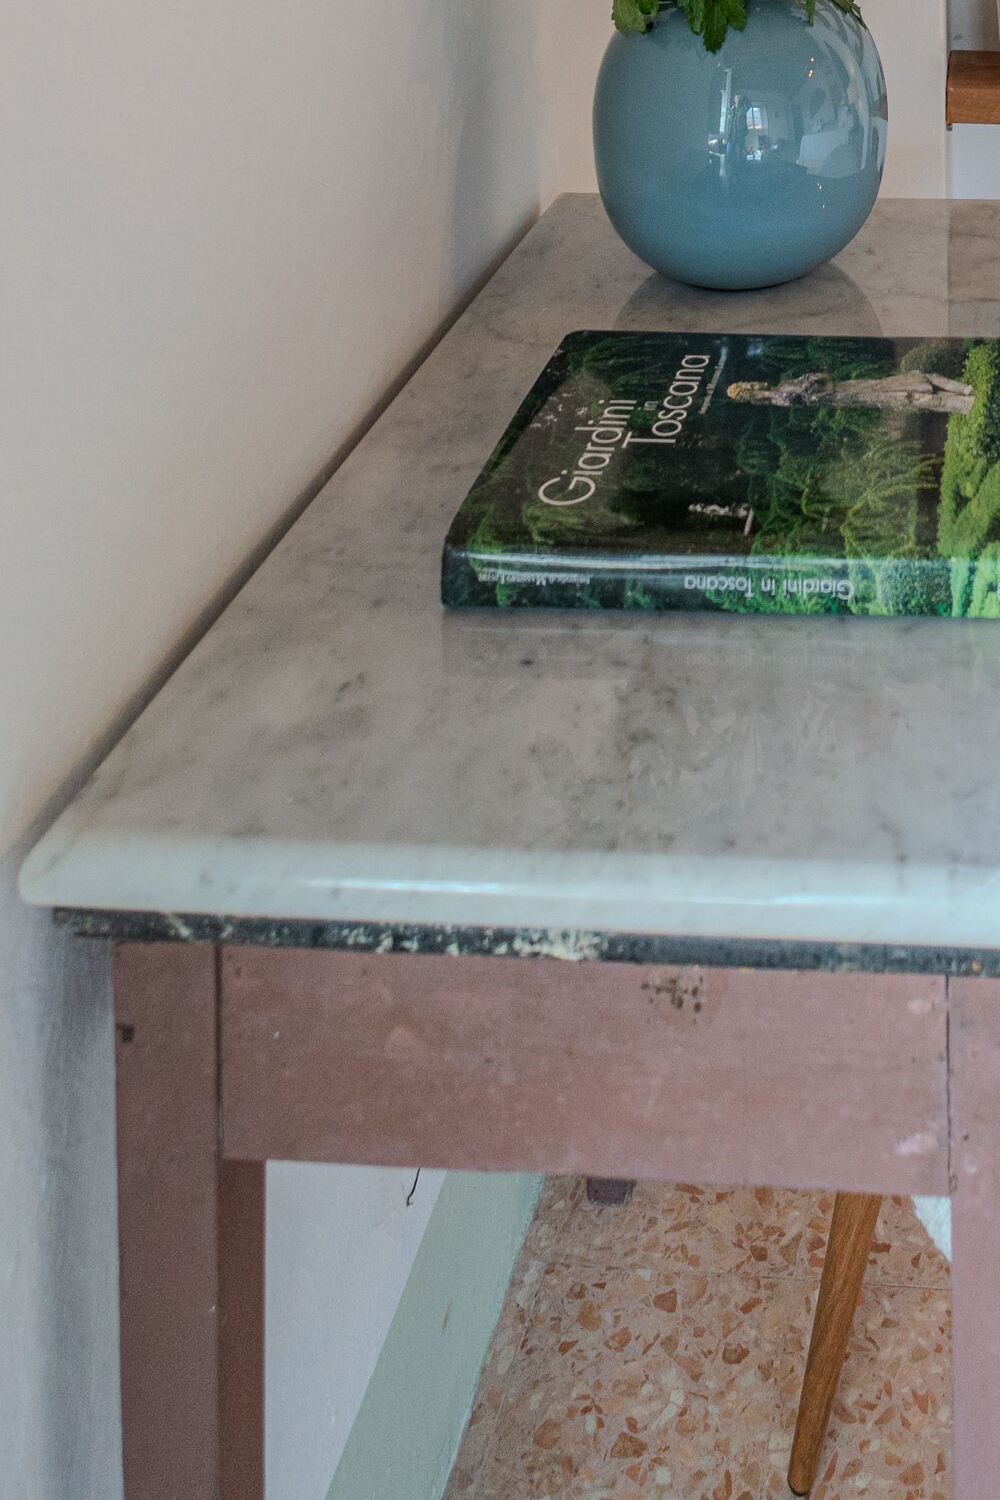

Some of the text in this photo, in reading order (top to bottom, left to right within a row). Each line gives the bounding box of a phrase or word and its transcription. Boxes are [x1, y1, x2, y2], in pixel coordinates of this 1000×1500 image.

[622, 354, 711, 449] Toscana
[638, 401, 658, 411] in
[538, 400, 637, 506] Giardini
[684, 574, 855, 600] Giardini in Toscana
